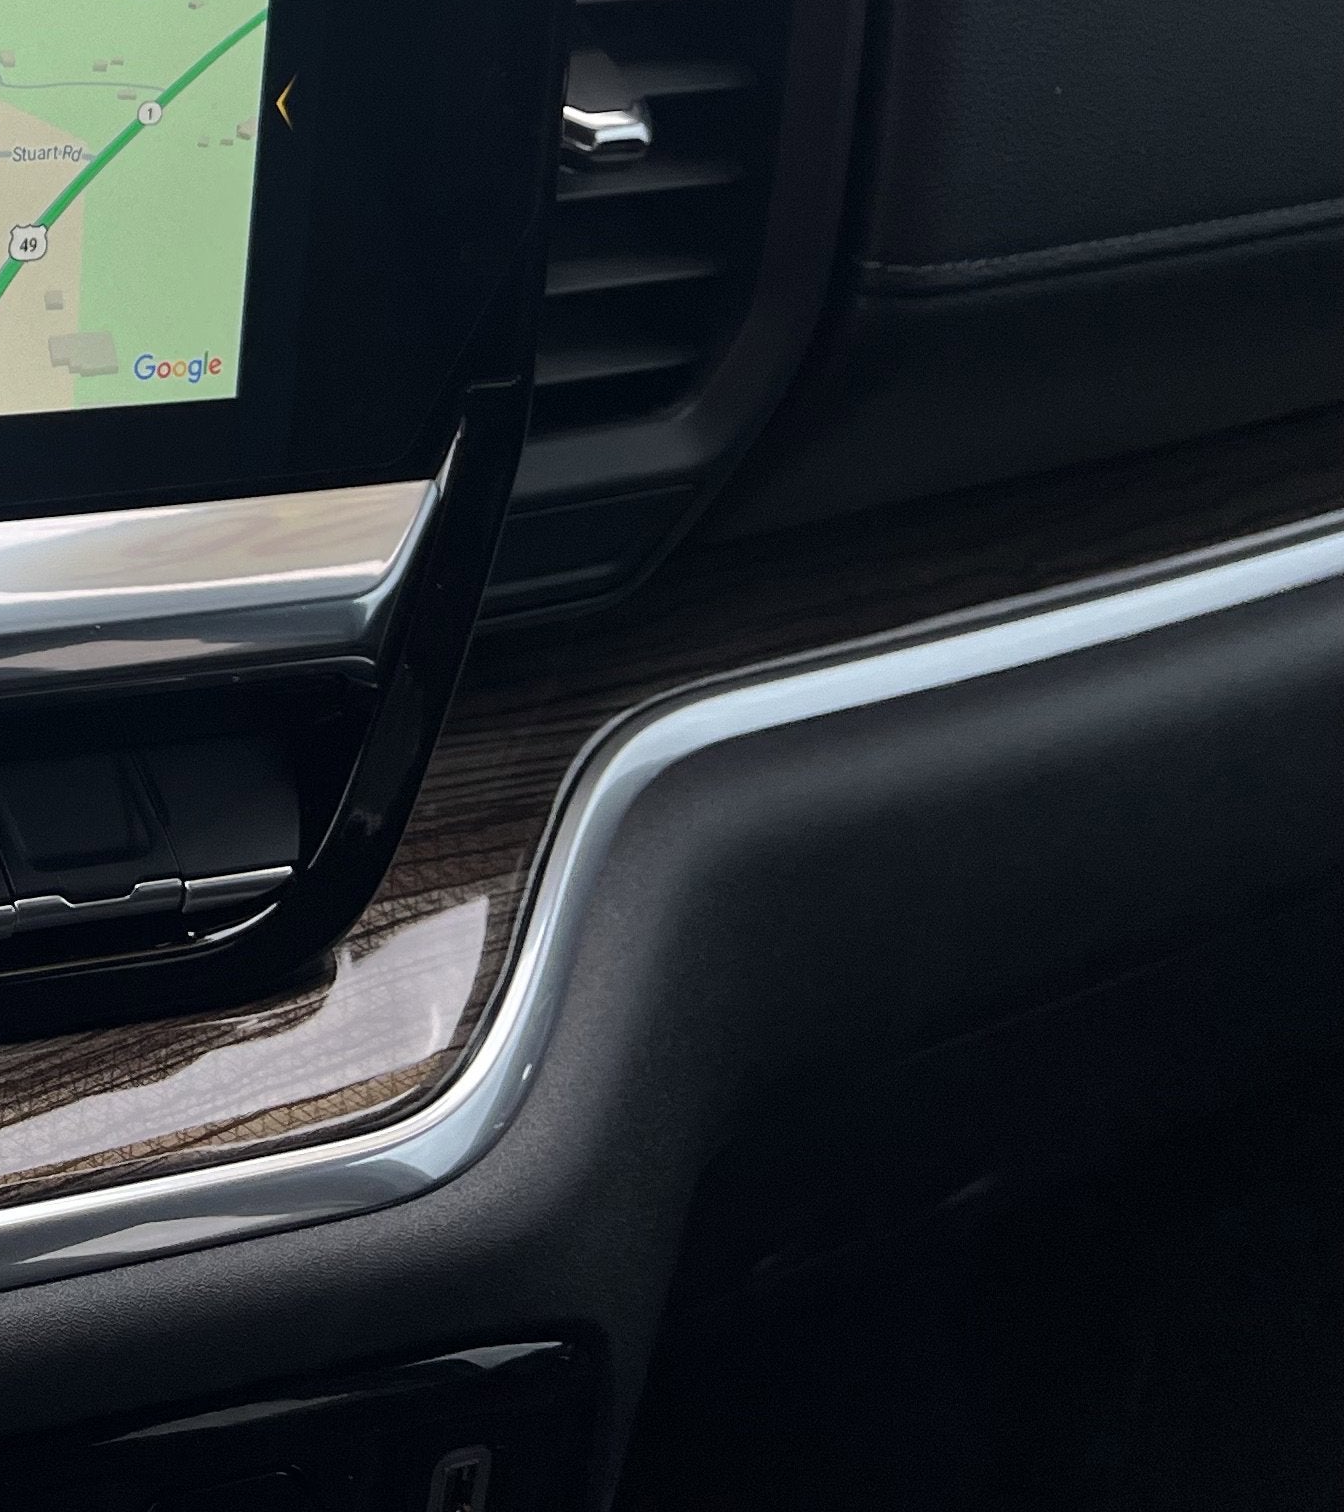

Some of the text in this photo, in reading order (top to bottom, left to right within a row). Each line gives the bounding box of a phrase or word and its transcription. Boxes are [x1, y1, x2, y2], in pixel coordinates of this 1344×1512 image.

[12, 145, 82, 162] Stuart Rd
[19, 237, 38, 253] 49
[133, 350, 223, 384] Google
